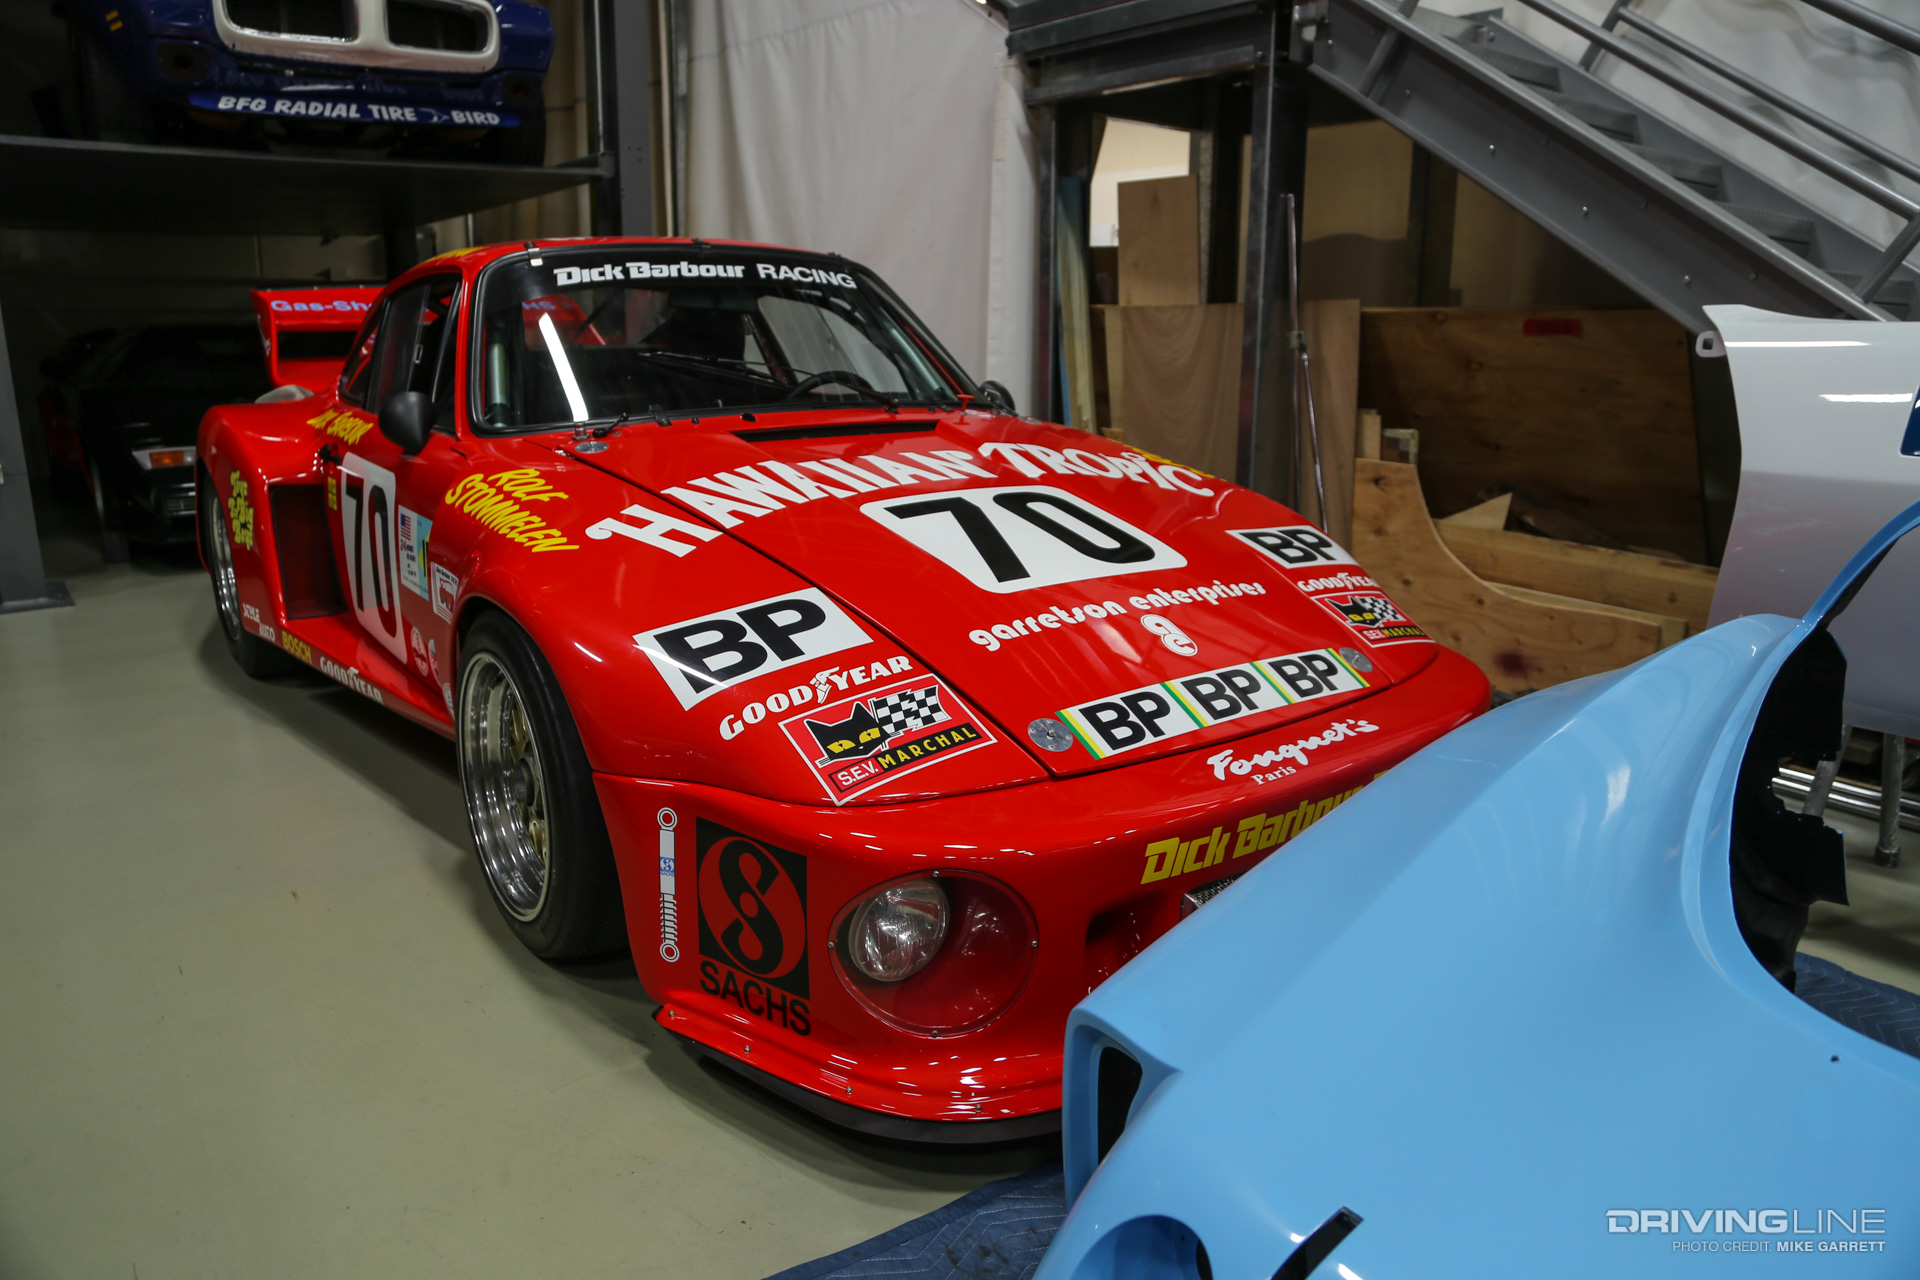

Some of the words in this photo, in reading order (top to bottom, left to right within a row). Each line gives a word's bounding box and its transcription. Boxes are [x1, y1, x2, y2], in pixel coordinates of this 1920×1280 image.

[217, 95, 267, 112] BFG
[273, 99, 361, 119] RADIAL
[367, 103, 417, 122] TIRE
[451, 110, 501, 126] BIRD
[553, 264, 626, 287] Dick
[626, 261, 745, 280] Barbour
[756, 263, 858, 289] RACING
[486, 468, 569, 502] ROLF
[978, 441, 1215, 497] TROPIC
[444, 473, 580, 553] STOMMELEN
[585, 449, 998, 558] HAWAIIAN
[345, 472, 398, 640] 70
[883, 490, 1157, 584] 70
[1240, 527, 1337, 565] BP
[653, 598, 826, 695] BP
[969, 600, 1128, 653] garretson
[1129, 579, 1267, 611] enterprises
[281, 630, 313, 665] BOSCH
[1078, 690, 1172, 752] BP
[1181, 668, 1263, 720] BP
[1267, 652, 1340, 698] BP
[837, 758, 879, 787] S.E.V.
[877, 726, 977, 770] MARCHAL
[1250, 764, 1298, 786] Paris
[1140, 825, 1231, 886] Dick
[699, 960, 813, 1037] SACHS
